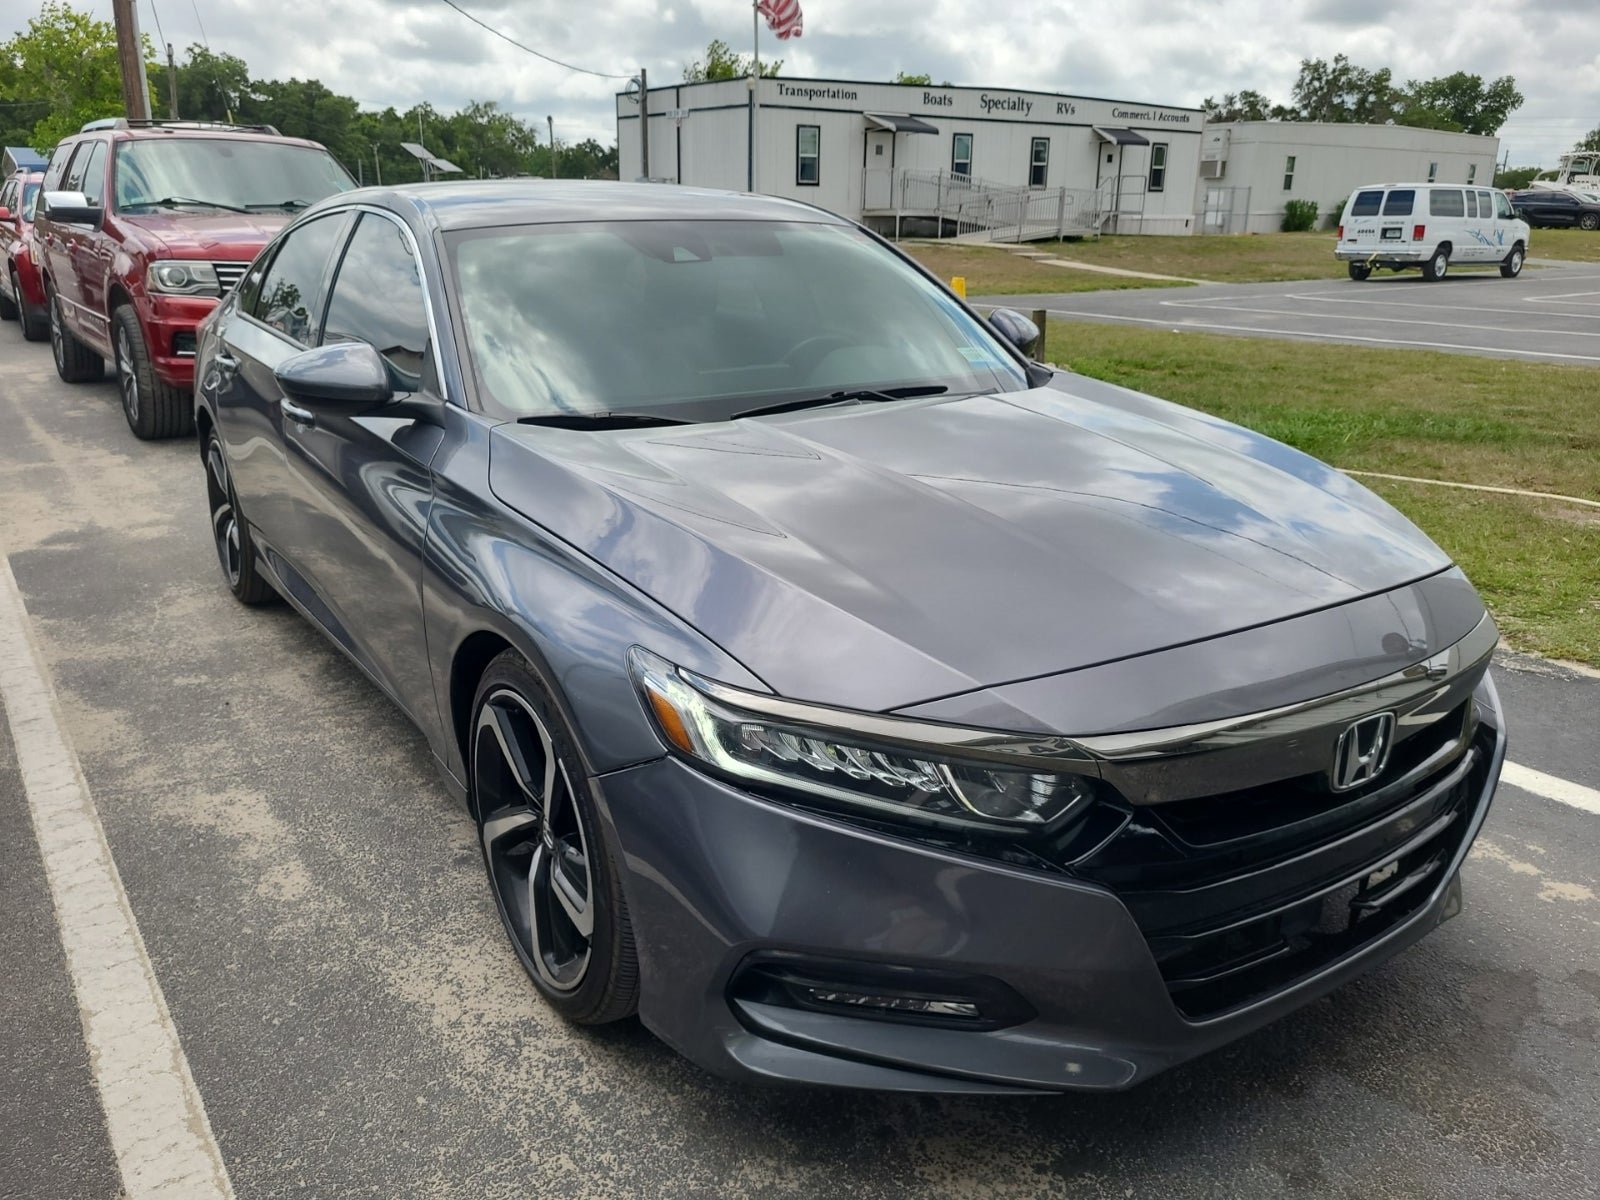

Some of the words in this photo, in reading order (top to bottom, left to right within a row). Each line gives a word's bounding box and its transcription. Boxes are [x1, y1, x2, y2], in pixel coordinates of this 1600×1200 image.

[777, 83, 858, 101] Transportation
[923, 91, 953, 107] Boats
[980, 93, 1033, 116] Specialty
[1056, 102, 1076, 115] RVs
[1112, 107, 1156, 121] Commercil
[1158, 111, 1190, 123] Accounts
